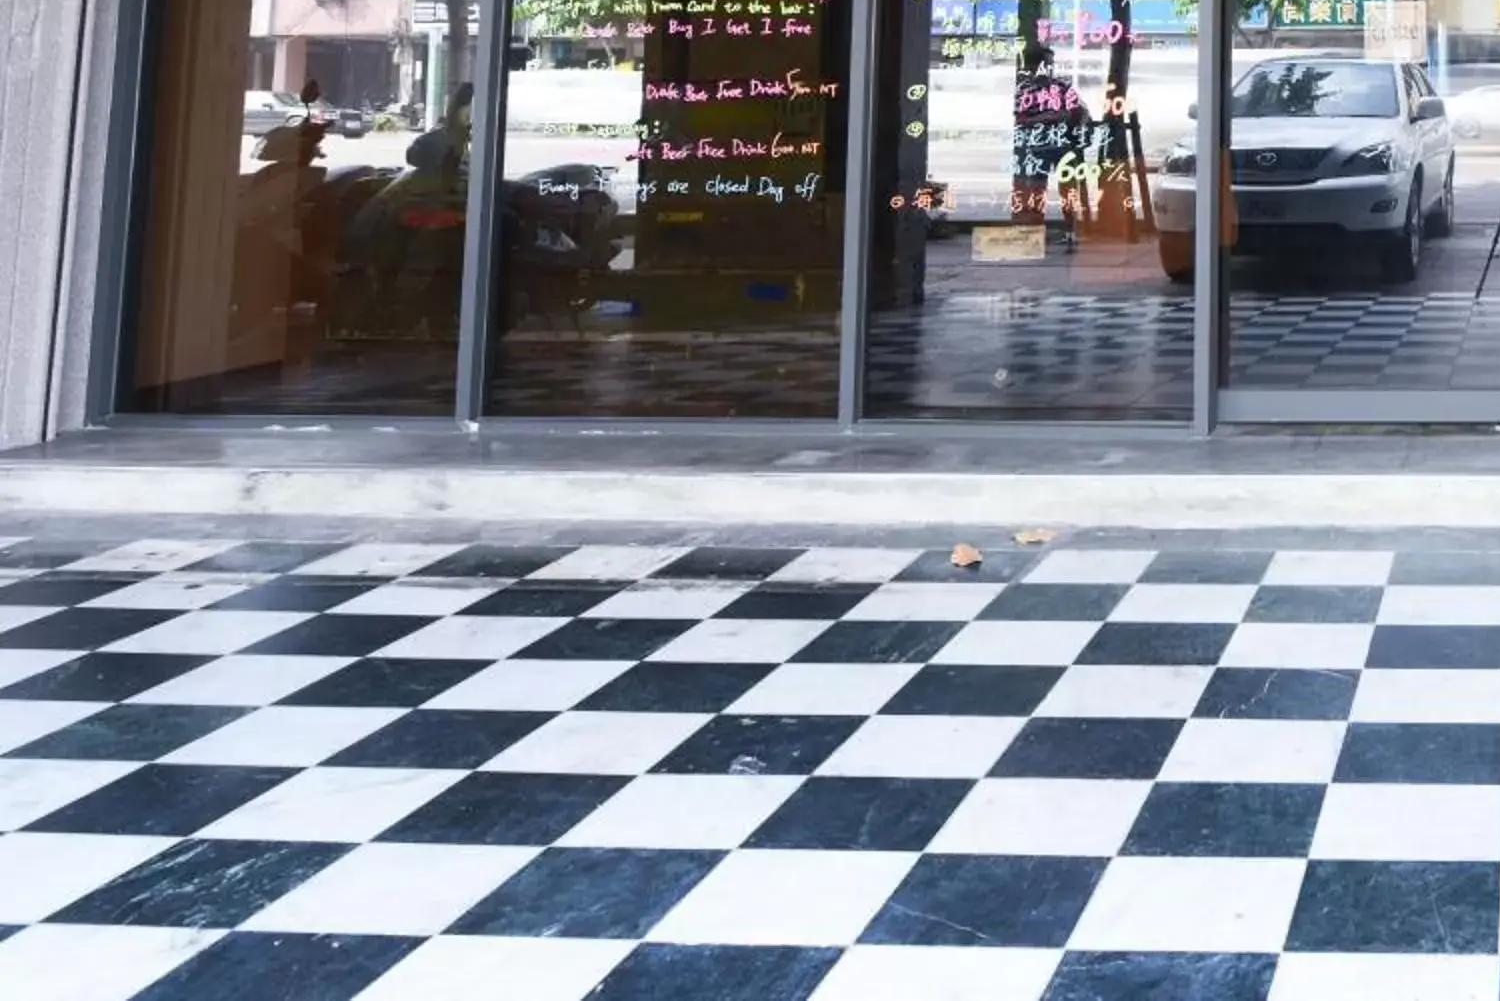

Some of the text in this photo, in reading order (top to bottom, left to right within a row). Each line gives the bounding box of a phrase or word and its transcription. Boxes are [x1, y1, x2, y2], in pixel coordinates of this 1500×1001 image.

[724, 0, 742, 13] to
[747, 0, 771, 14] the
[668, 18, 693, 39] Buy
[661, 142, 691, 160] Beer
[697, 137, 726, 158] Free
[667, 180, 689, 194] are
[756, 176, 784, 203] Day
[794, 172, 822, 202] off
